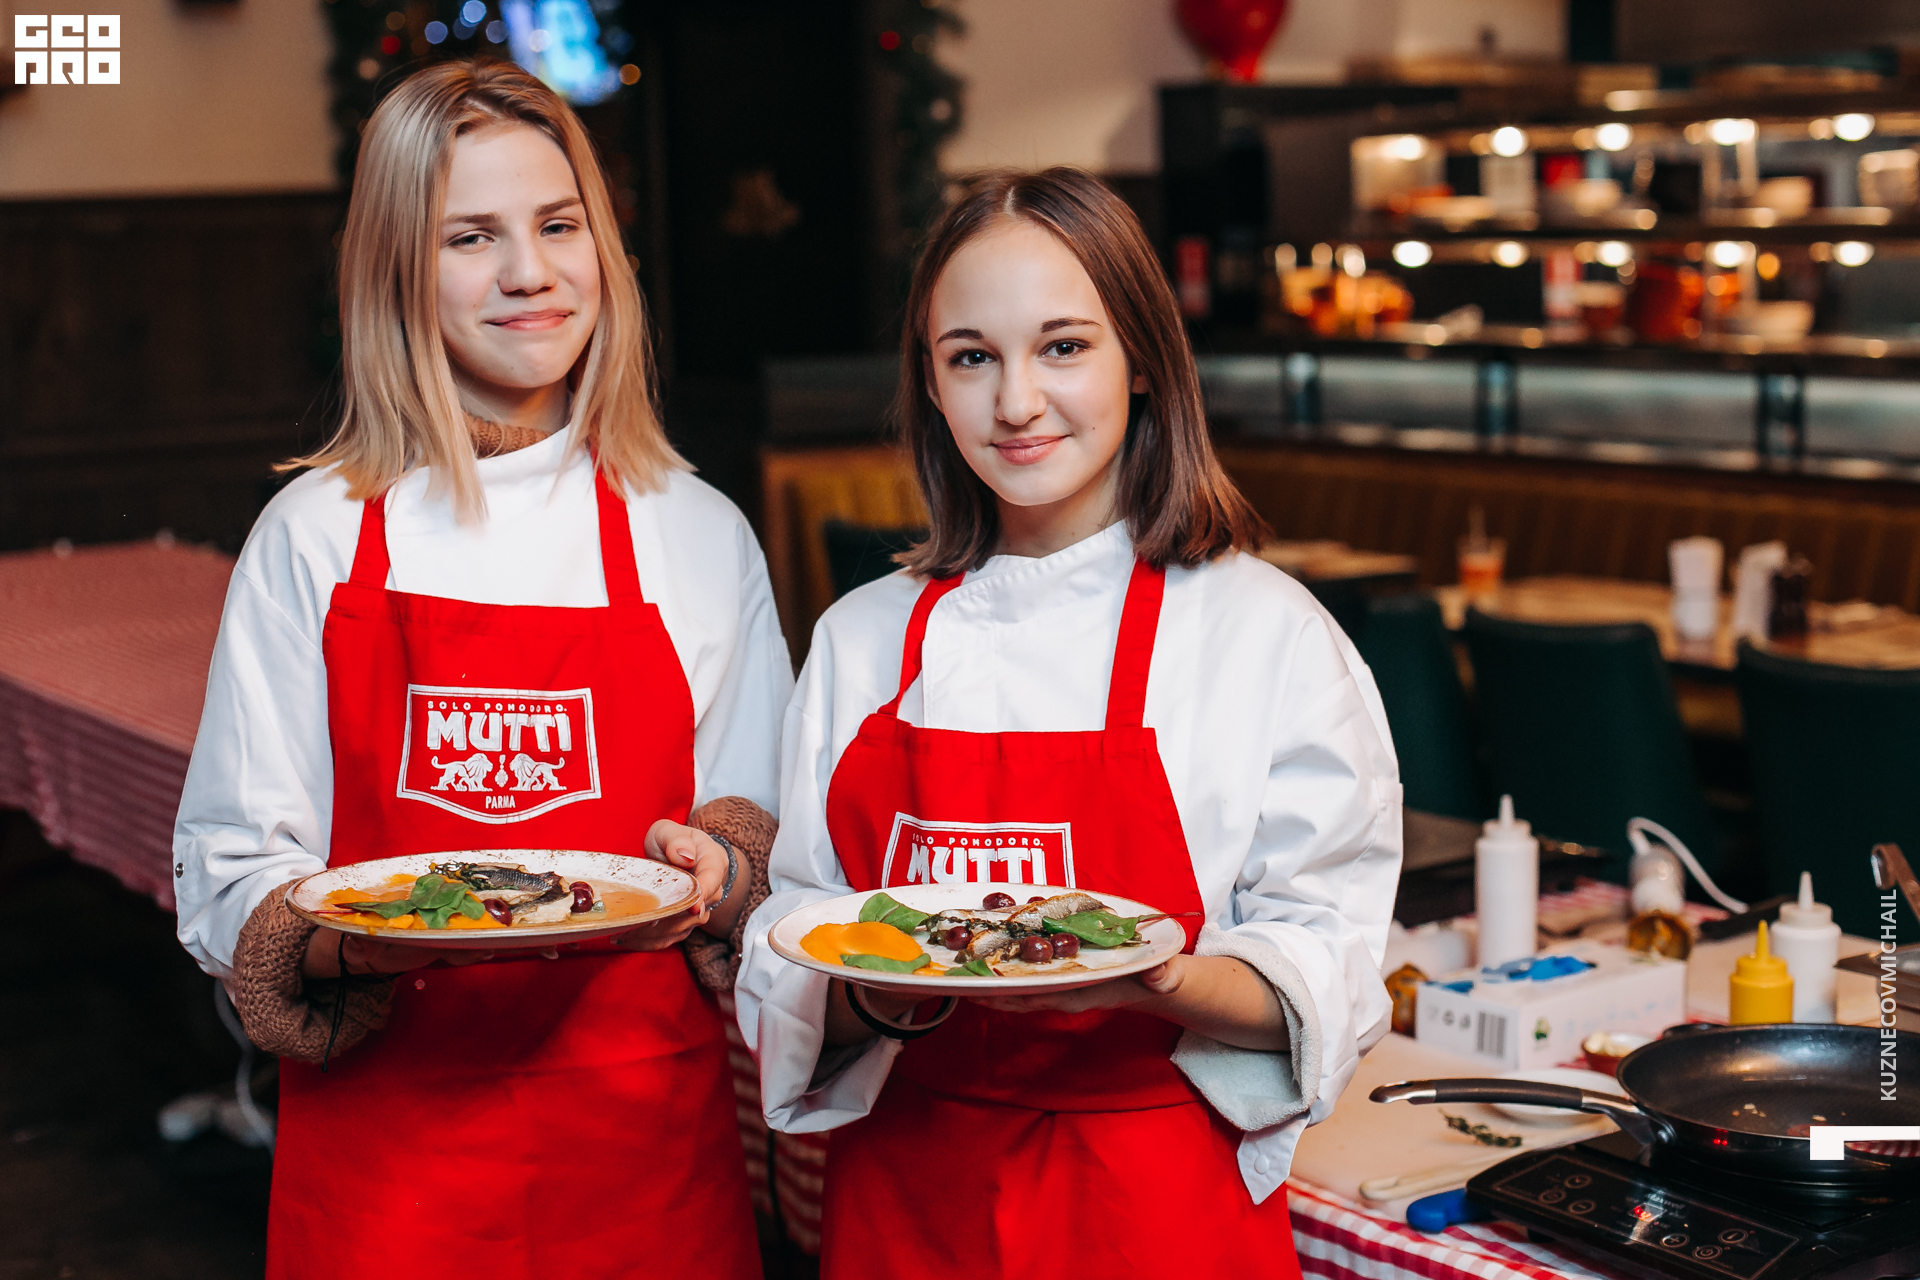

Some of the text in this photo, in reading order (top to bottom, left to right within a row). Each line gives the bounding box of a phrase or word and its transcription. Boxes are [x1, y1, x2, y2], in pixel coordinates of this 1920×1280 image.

[428, 701, 471, 710] SOLO
[426, 711, 572, 752] MUTTI
[485, 796, 516, 809] PARMA
[906, 843, 1047, 885] MUTTI
